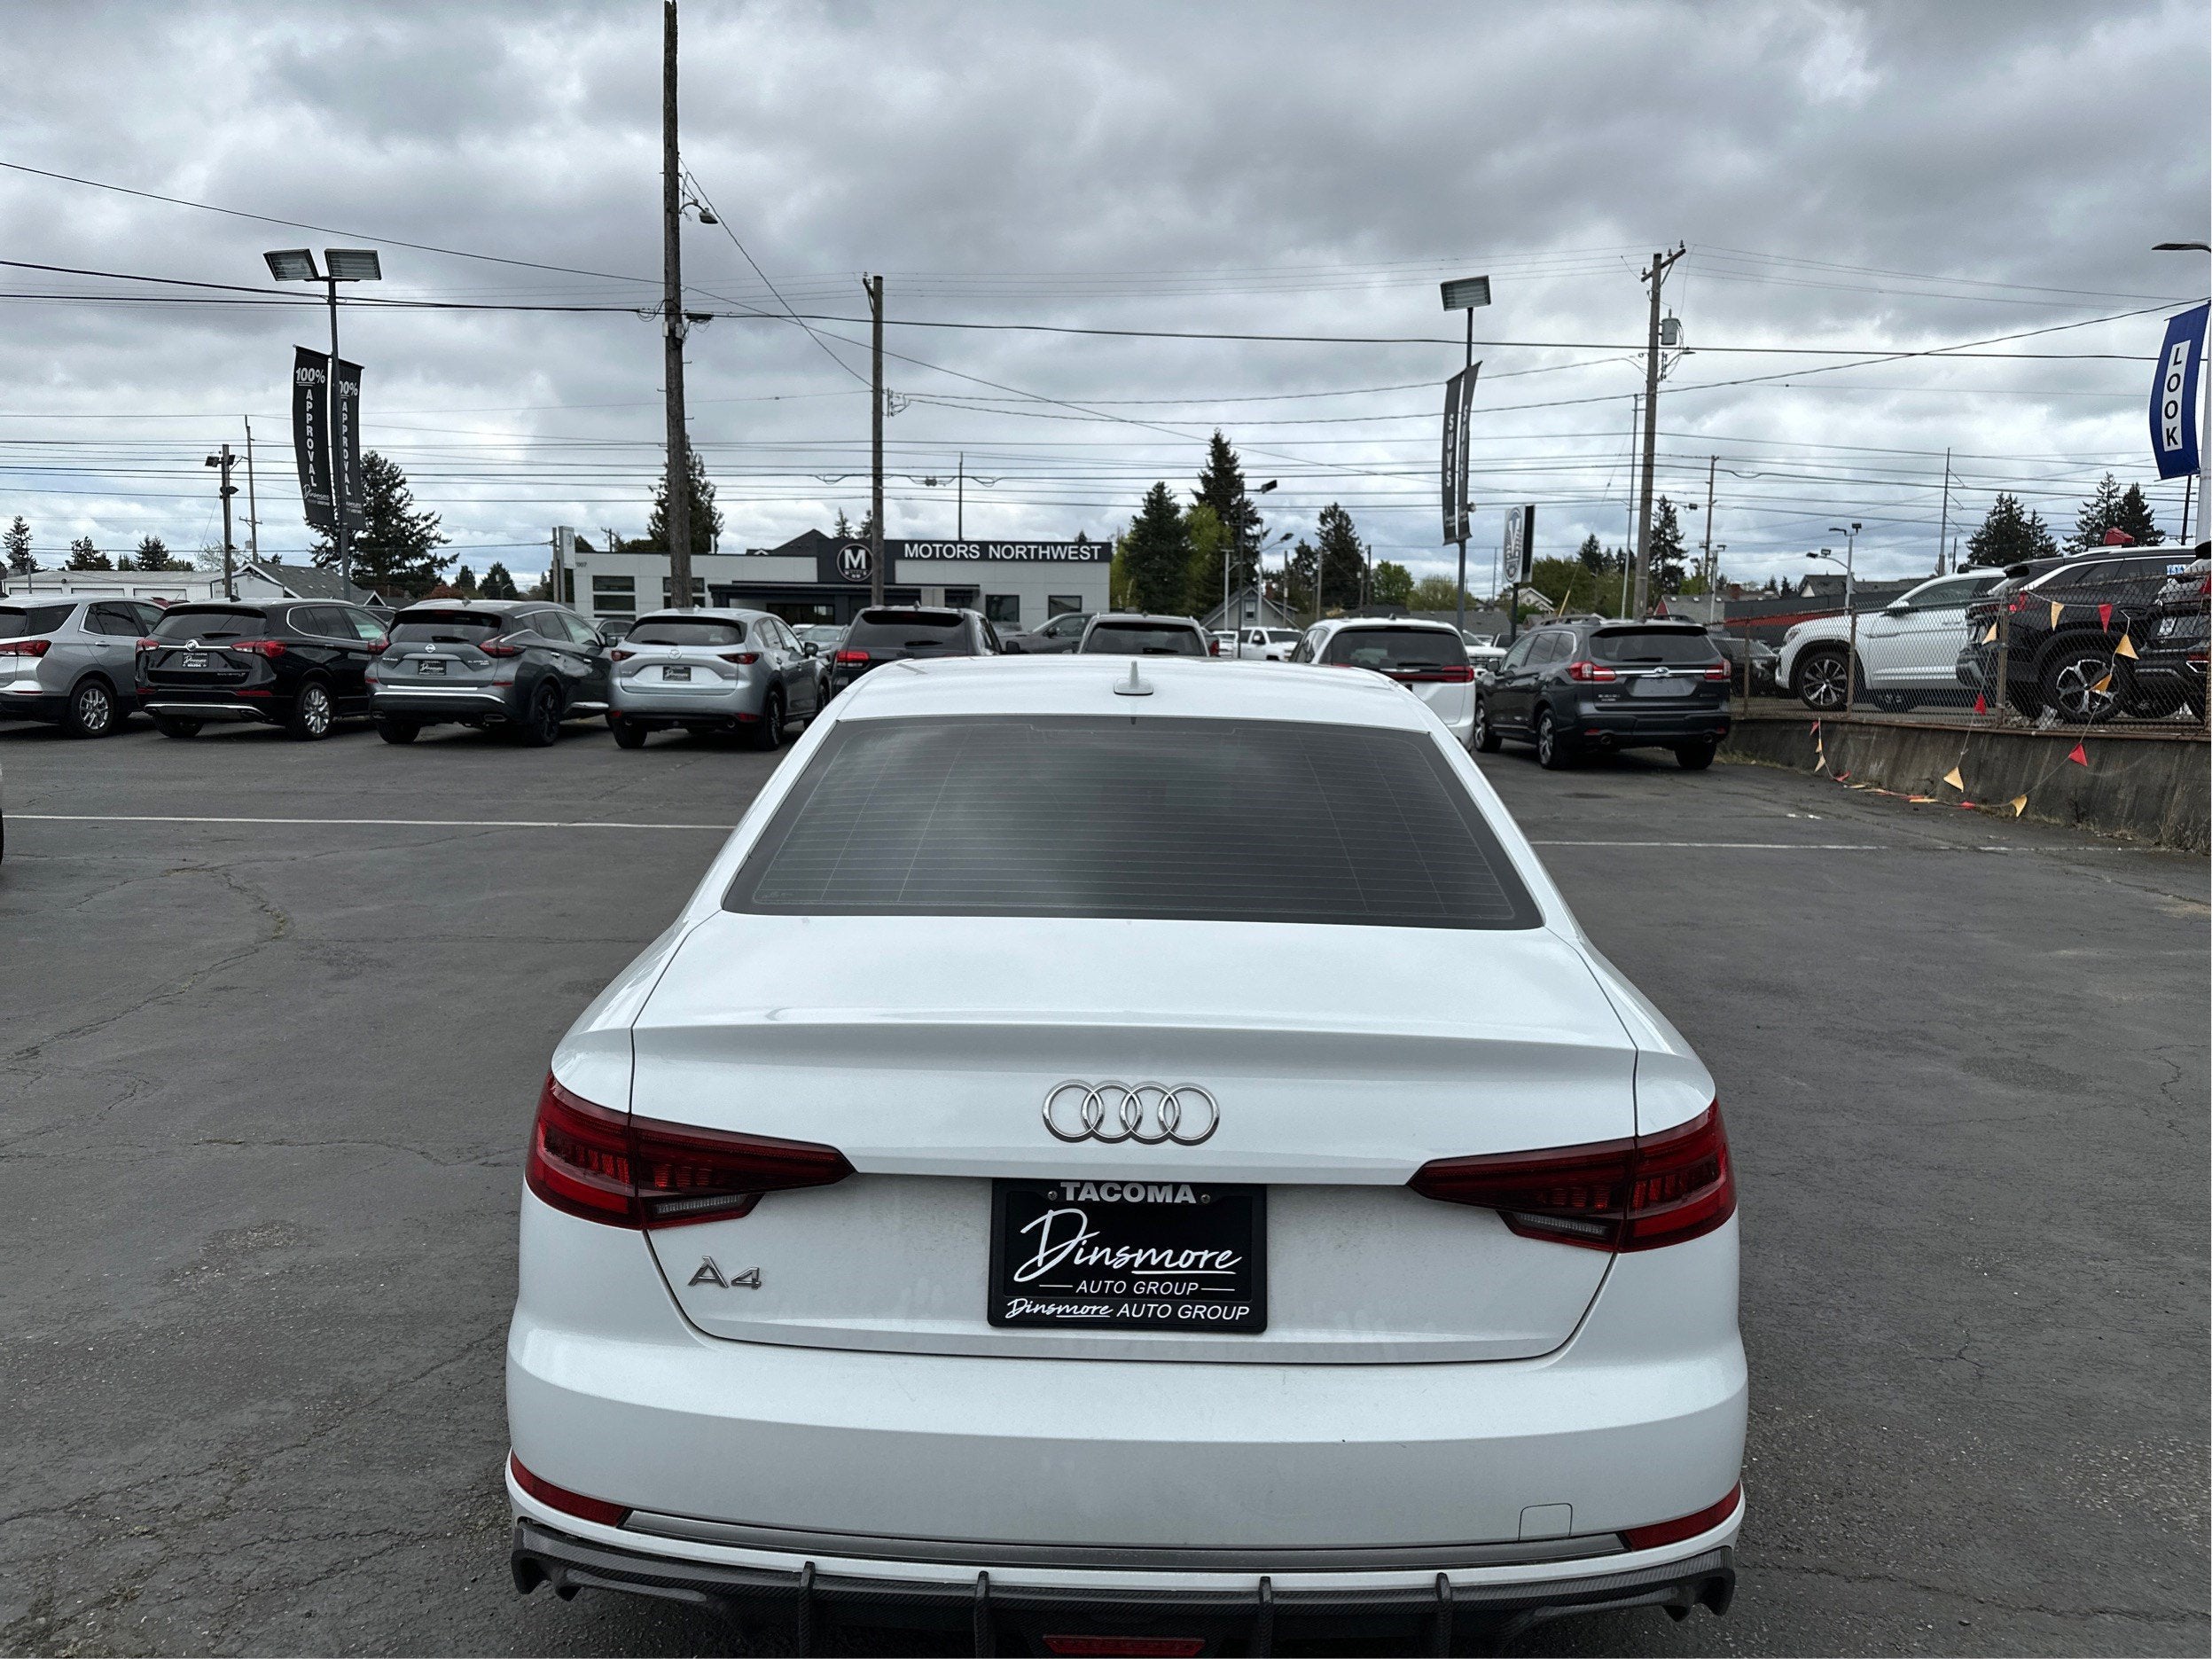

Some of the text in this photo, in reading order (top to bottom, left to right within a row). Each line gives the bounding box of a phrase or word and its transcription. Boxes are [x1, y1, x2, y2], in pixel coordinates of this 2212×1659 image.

[295, 367, 325, 384] 100%
[2164, 347, 2183, 447] LOOK
[305, 388, 317, 487] APPROVAL
[341, 401, 352, 496] APPROVAL
[844, 549, 866, 569] M
[904, 543, 1102, 560] MOTORS NORTHWEST
[1060, 1181, 1197, 1204] TACOMA
[1013, 1208, 1242, 1282] Dinsmore
[687, 1256, 762, 1290] A4
[1075, 1280, 1199, 1295] AUTO GROUP
[1004, 1298, 1249, 1320] Dinsmore AUTO GROUP
